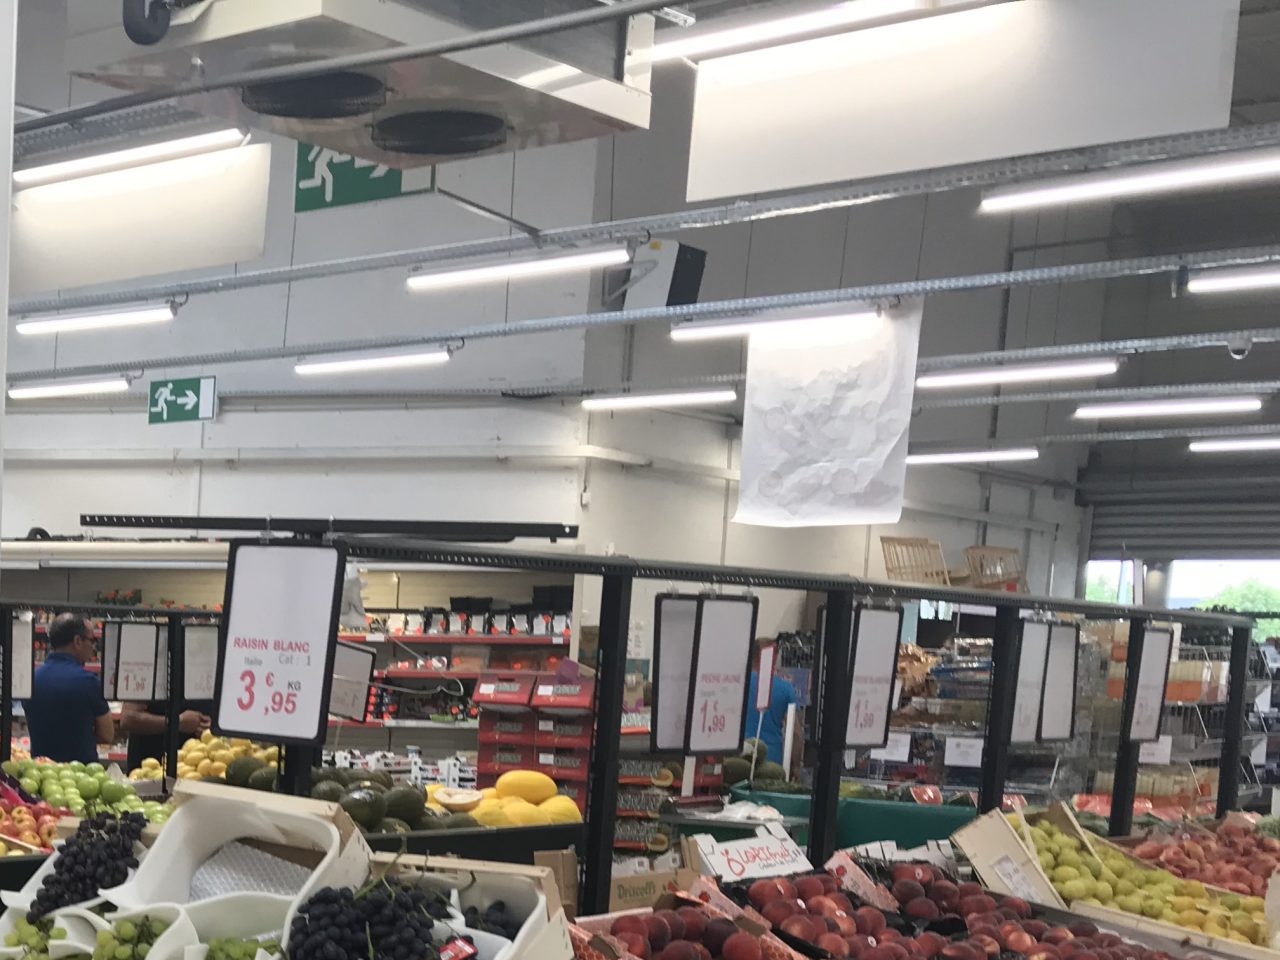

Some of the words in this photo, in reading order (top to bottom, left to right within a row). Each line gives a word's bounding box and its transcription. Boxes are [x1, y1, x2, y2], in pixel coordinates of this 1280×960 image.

[233, 636, 268, 650] RAISIN
[273, 639, 310, 653] BLANC
[287, 681, 301, 690] KG
